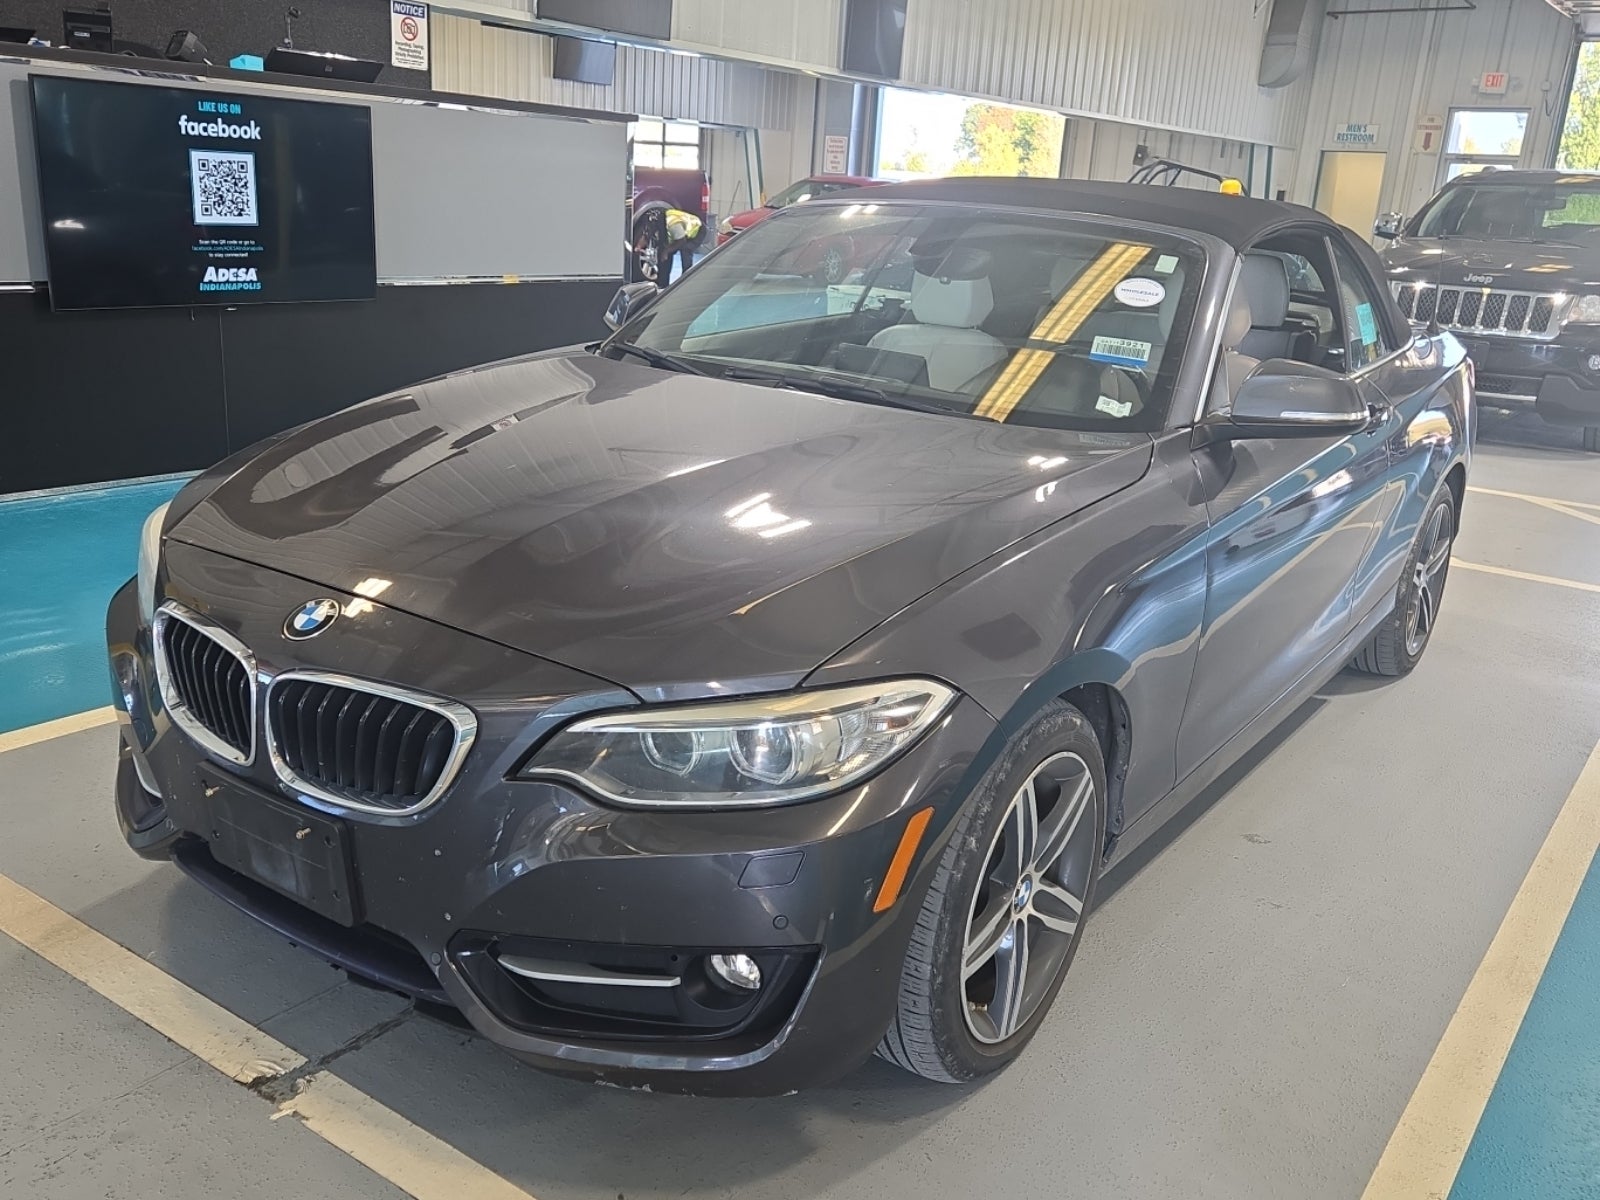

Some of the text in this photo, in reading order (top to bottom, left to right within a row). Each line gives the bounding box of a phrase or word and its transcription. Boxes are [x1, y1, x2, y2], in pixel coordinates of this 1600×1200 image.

[394, 3, 424, 16] NOTICE
[1485, 74, 1504, 88] EXIT
[198, 101, 241, 114] LIKE US ON
[178, 114, 261, 140] facebook
[1345, 123, 1368, 133] MEN'S
[1336, 132, 1375, 143] RESTROOM
[203, 266, 258, 282] ADESA
[1463, 273, 1493, 284] Jeep
[199, 282, 262, 291] INDIANAPOLIS
[1120, 339, 1145, 348] 3921
